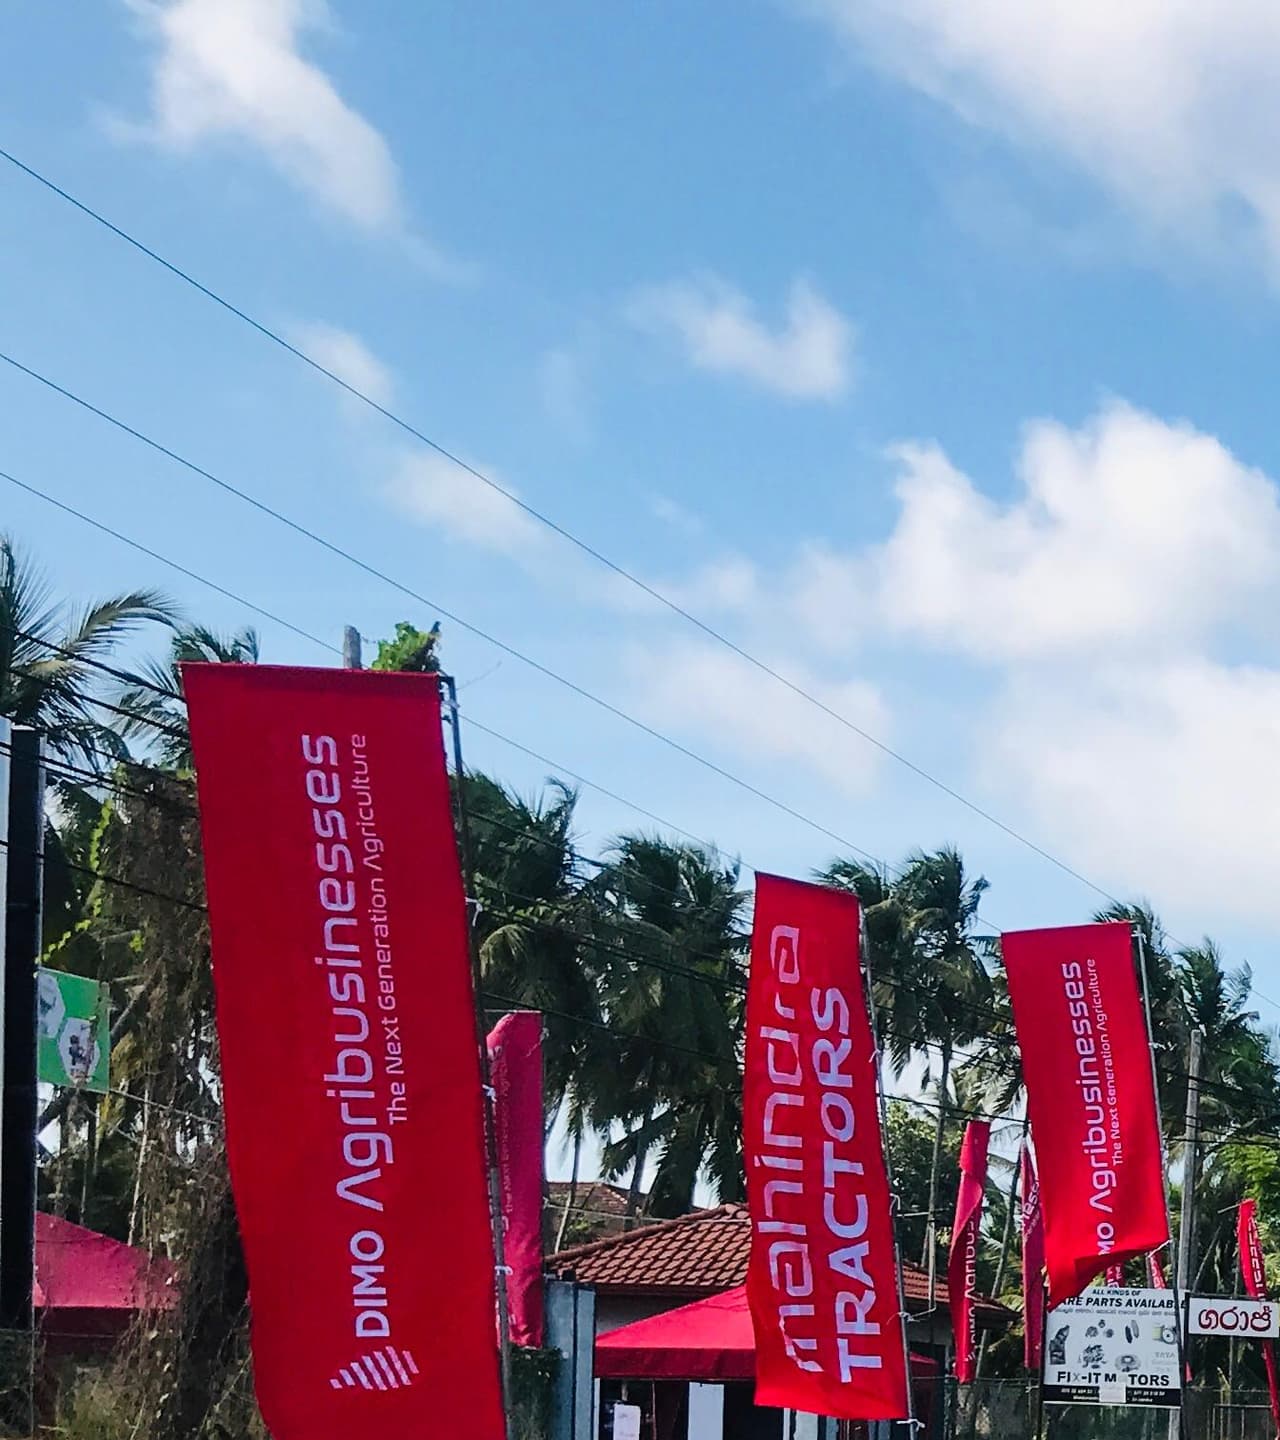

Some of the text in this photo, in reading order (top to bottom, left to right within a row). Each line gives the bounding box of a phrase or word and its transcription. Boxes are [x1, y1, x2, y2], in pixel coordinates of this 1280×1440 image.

[301, 734, 394, 1338] DIMO Agribusinesses
[351, 734, 408, 1125] The Next Generation Agriculture
[1062, 961, 1118, 1213] Agribusinesses
[1087, 958, 1123, 1166] The Next Generation Agriculture
[754, 924, 824, 1373] mahindra
[811, 986, 883, 1384] TRACTORS
[1085, 1298, 1123, 1308] PARTS
[1125, 1299, 1187, 1309] AVAILABE
